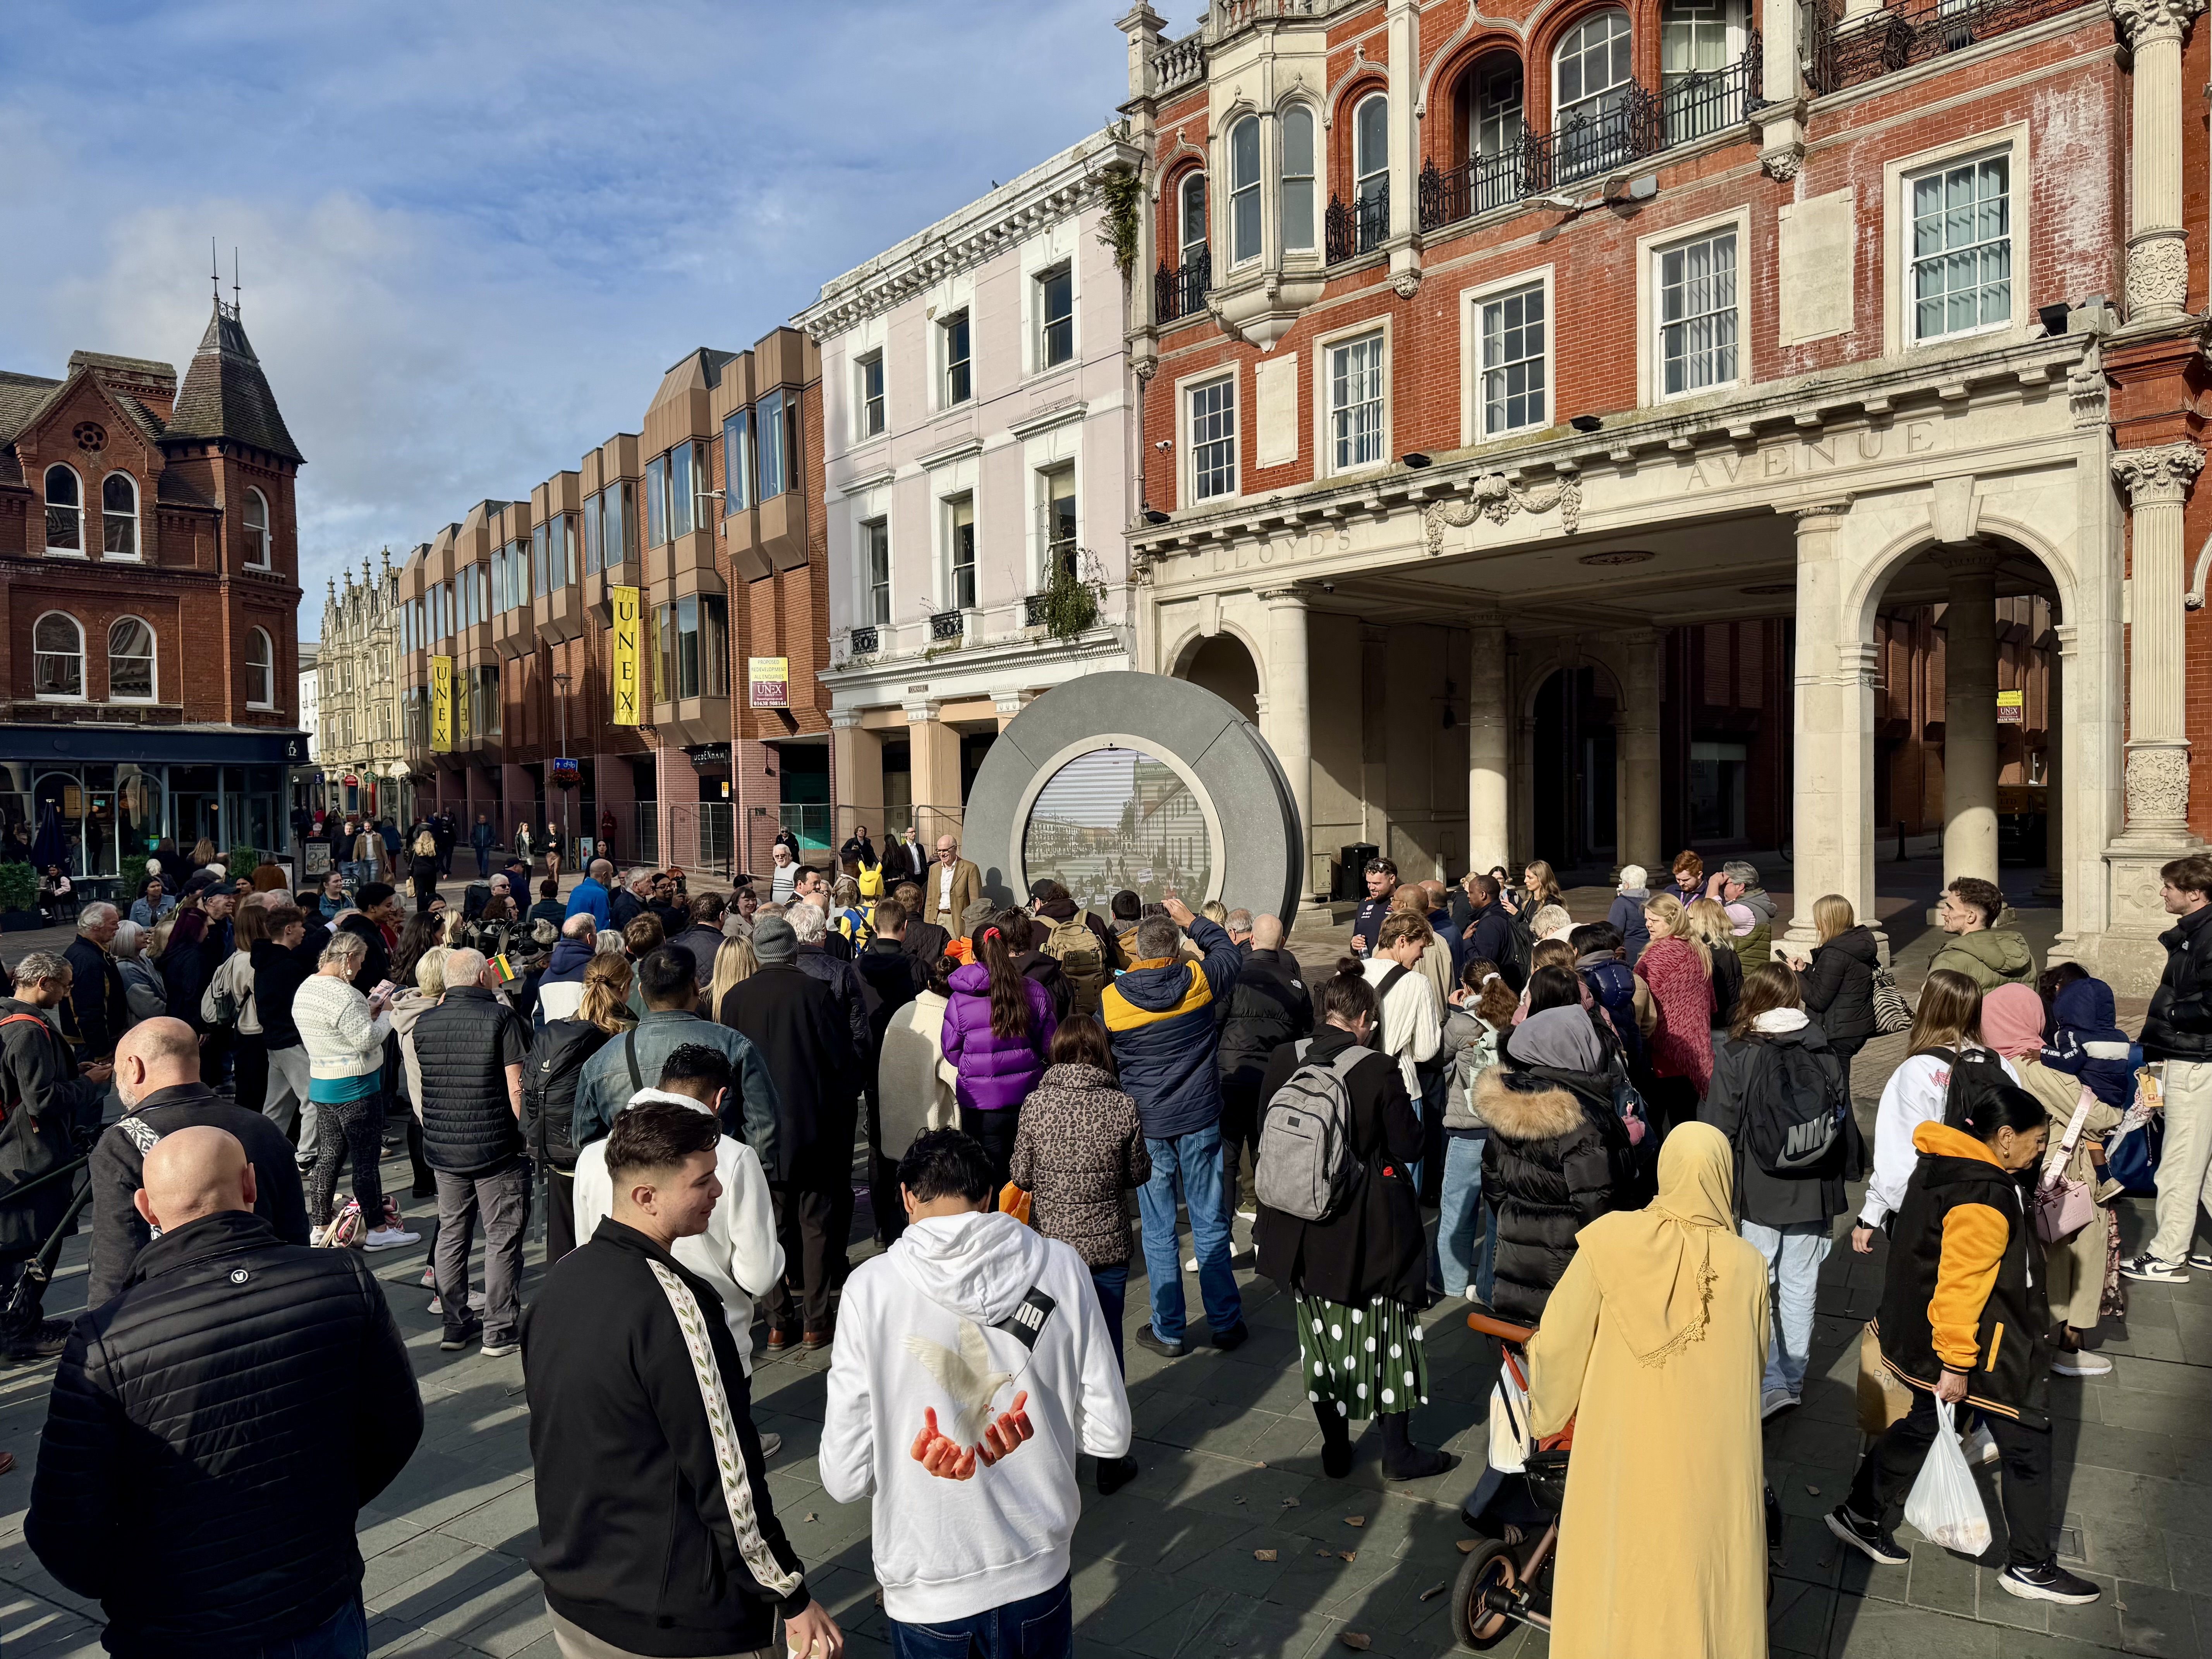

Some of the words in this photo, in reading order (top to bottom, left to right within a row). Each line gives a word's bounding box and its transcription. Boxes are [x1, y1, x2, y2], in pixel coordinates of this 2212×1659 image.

[1212, 529, 1351, 572] LLOYDS
[1686, 421, 1934, 490] AVENUE
[617, 601, 634, 711] UNEX
[757, 685, 782, 694] UNEX
[436, 667, 447, 742] UNEX
[694, 750, 724, 761] DEBENHAM
